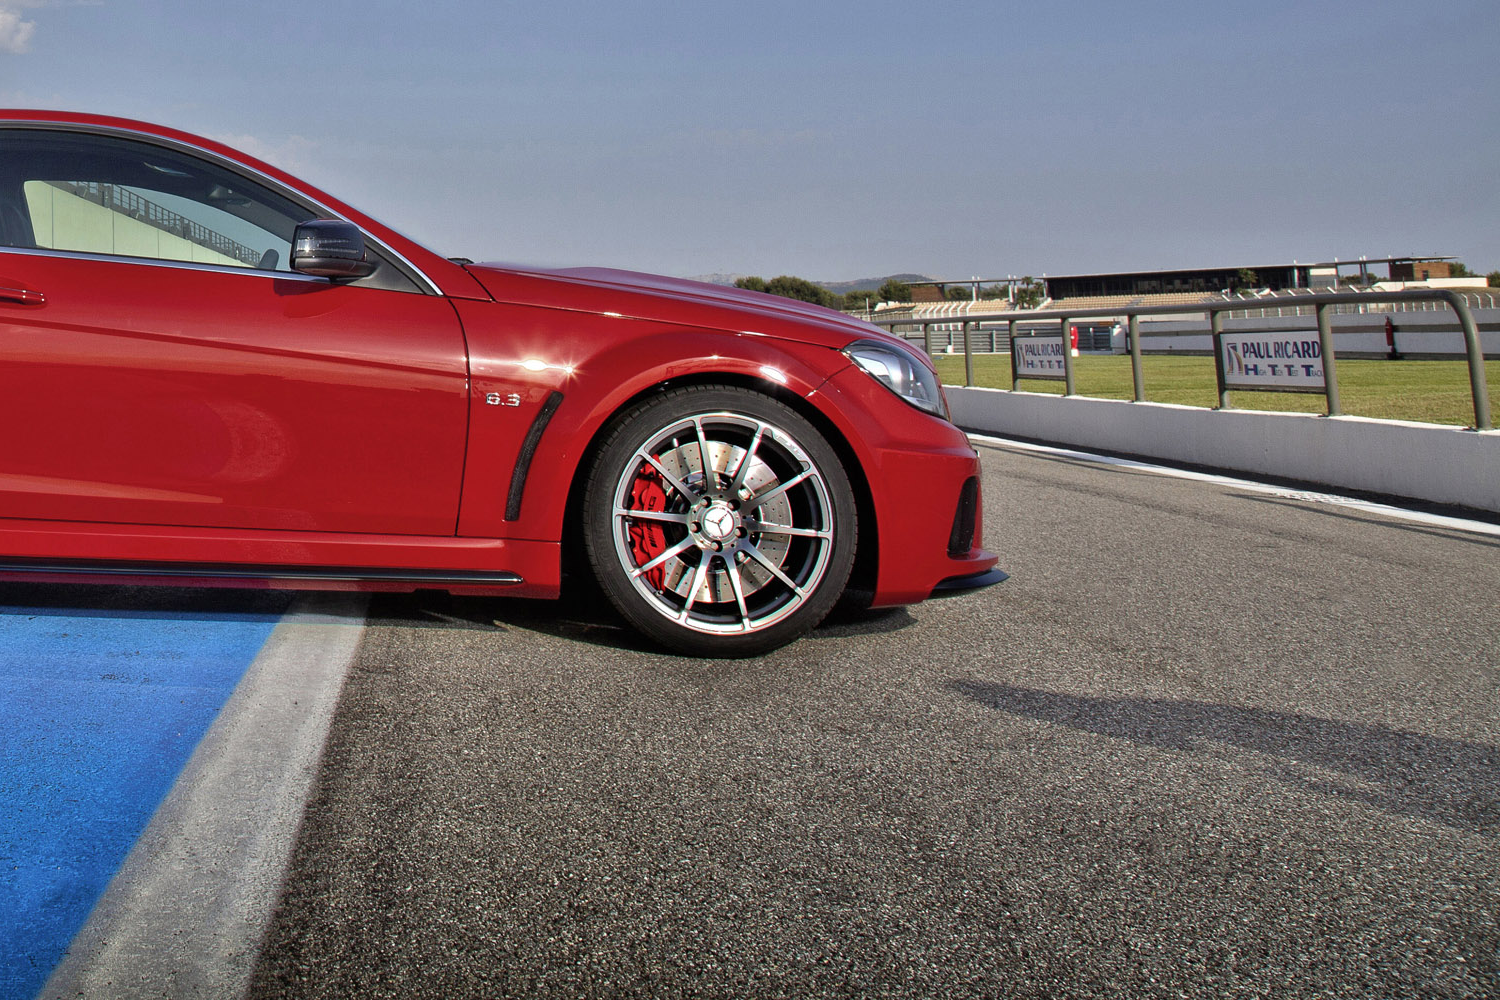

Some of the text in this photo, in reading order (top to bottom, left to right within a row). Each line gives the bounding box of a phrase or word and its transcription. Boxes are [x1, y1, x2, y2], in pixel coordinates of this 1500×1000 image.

[1242, 341, 1321, 359] PAUL RICARD
[486, 392, 520, 407] 6.3
